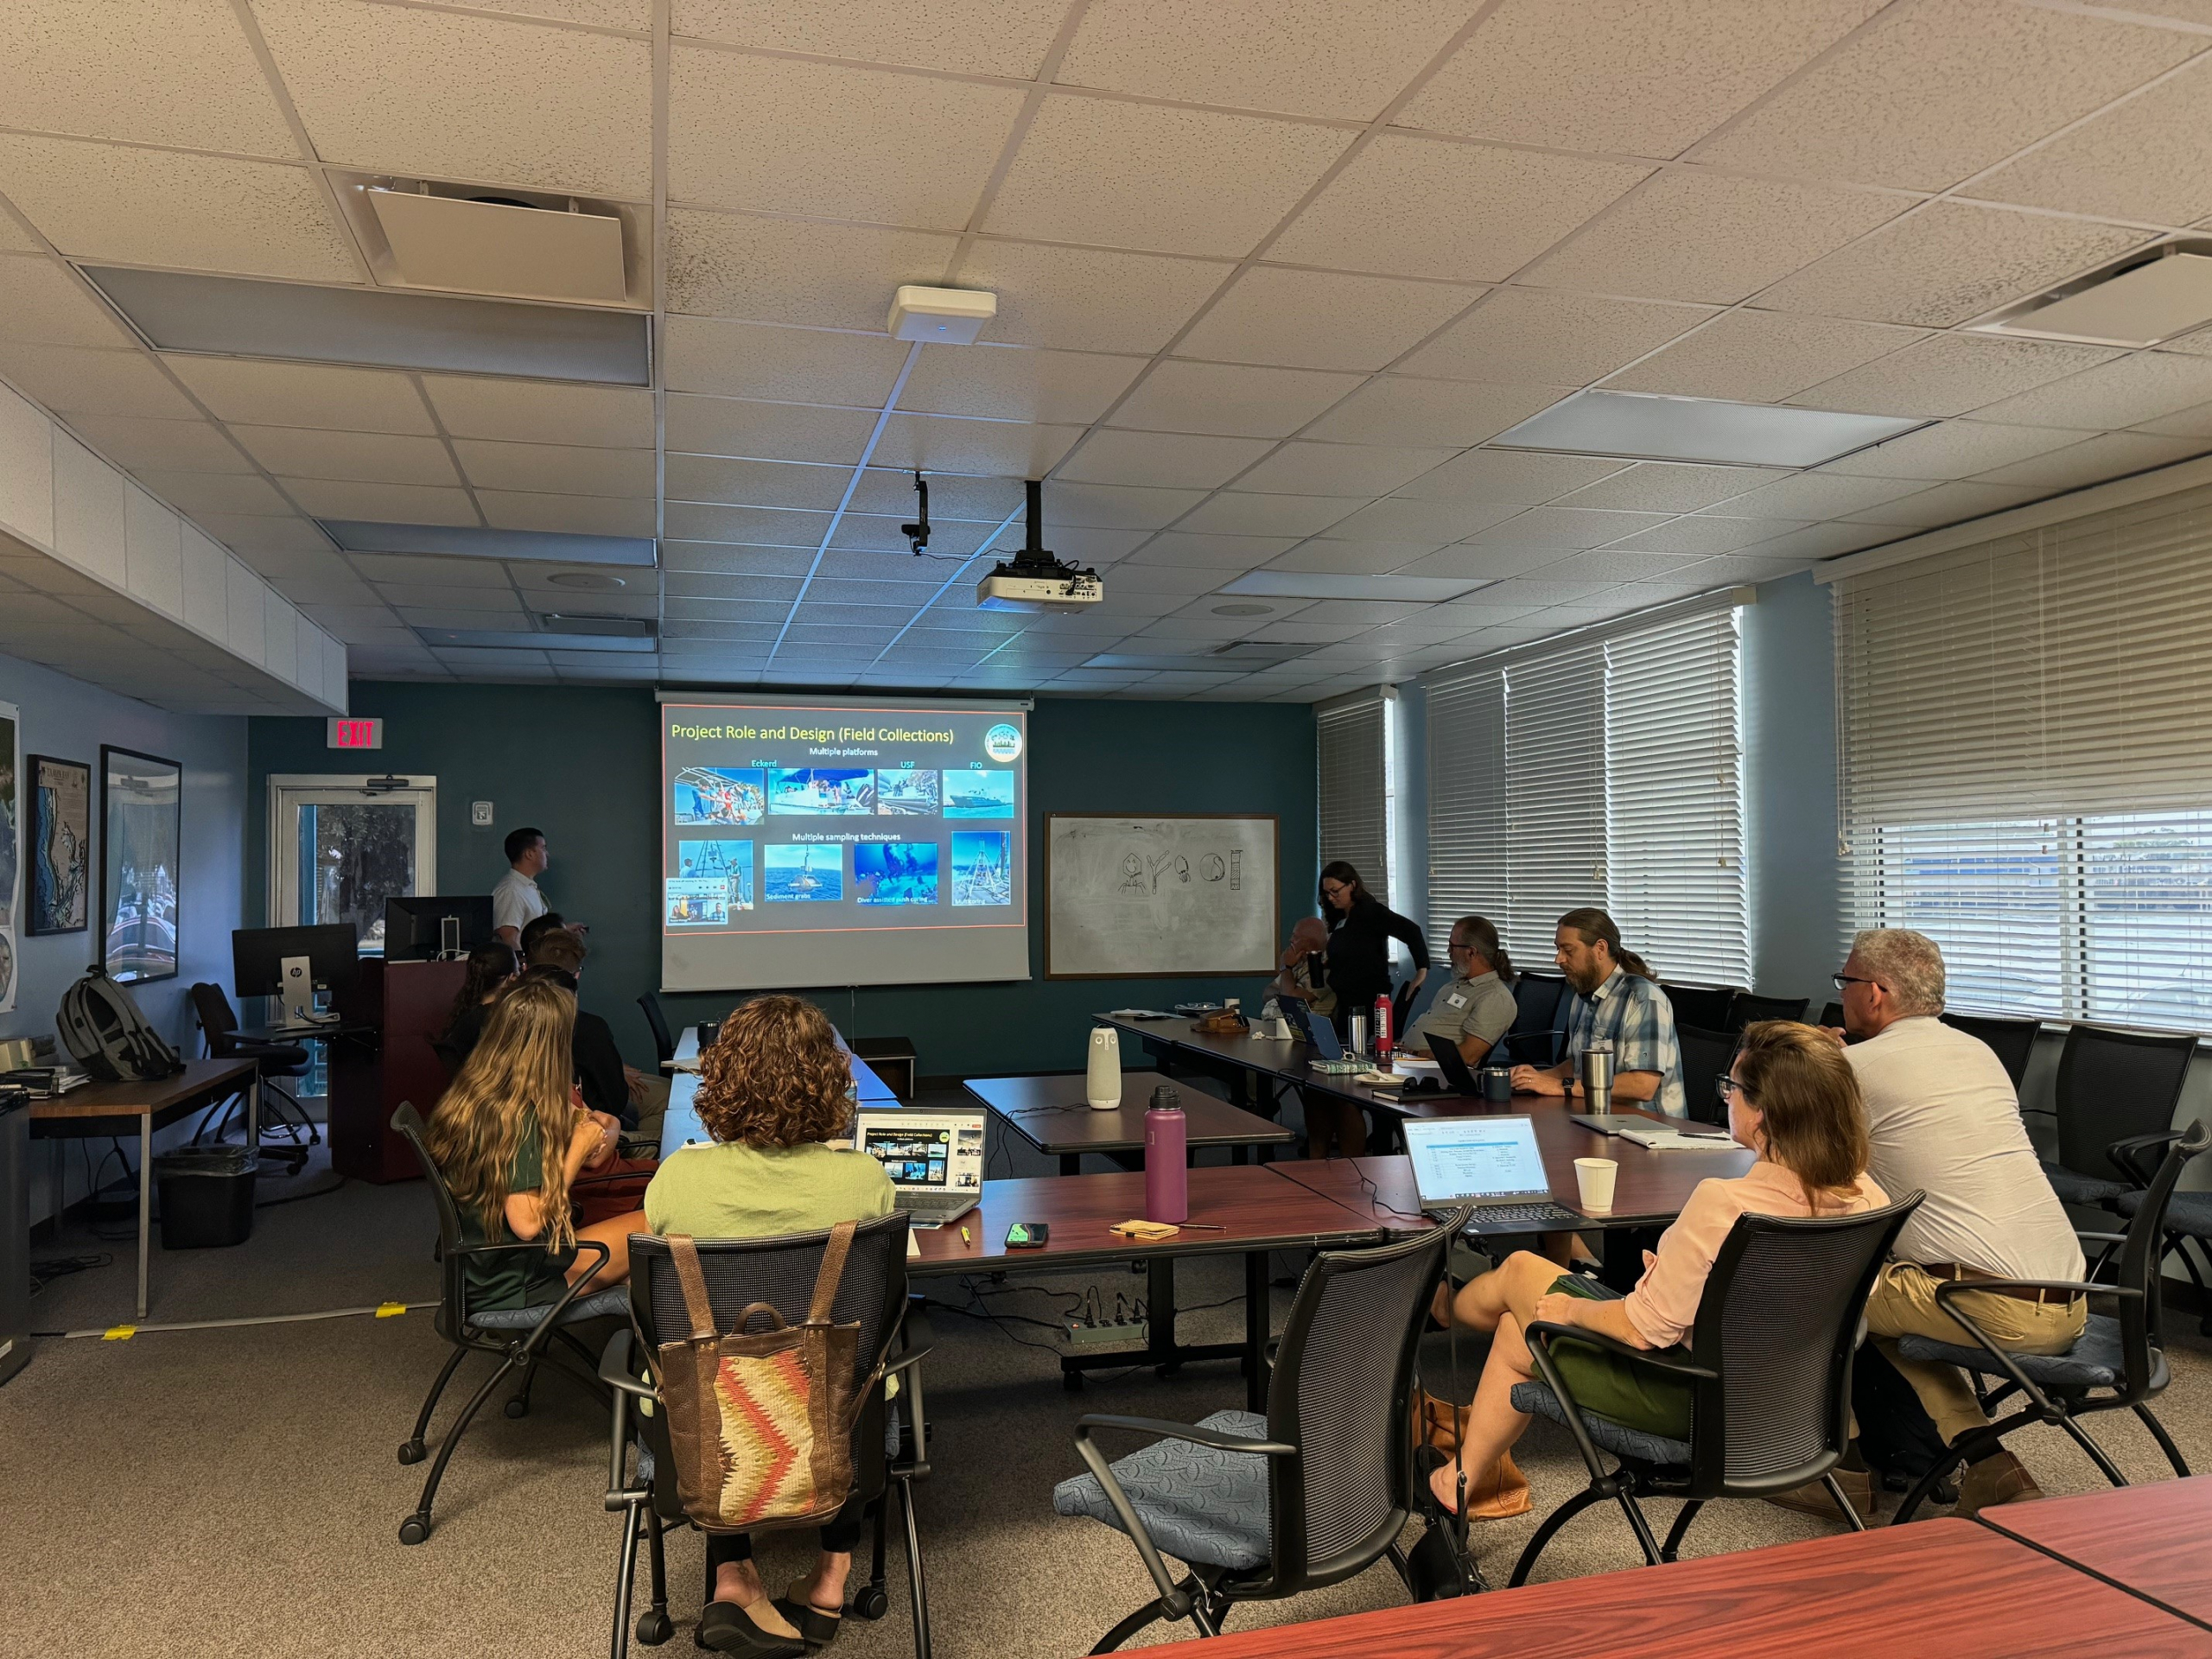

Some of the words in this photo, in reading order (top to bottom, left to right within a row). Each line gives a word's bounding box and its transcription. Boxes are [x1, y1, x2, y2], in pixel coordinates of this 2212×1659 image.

[338, 721, 374, 748] EXIT
[671, 724, 722, 741] Project
[726, 725, 756, 738] Role
[760, 727, 785, 740] and
[790, 727, 835, 742] Design
[839, 727, 875, 743] (Field
[878, 728, 954, 745] Collections)
[809, 747, 842, 756] Multiple
[842, 748, 879, 758] platforms
[751, 760, 777, 768] Eckerd
[792, 832, 825, 842] Multiple
[825, 833, 860, 842] sampling
[860, 832, 901, 842] techniques
[290, 967, 302, 978] hp
